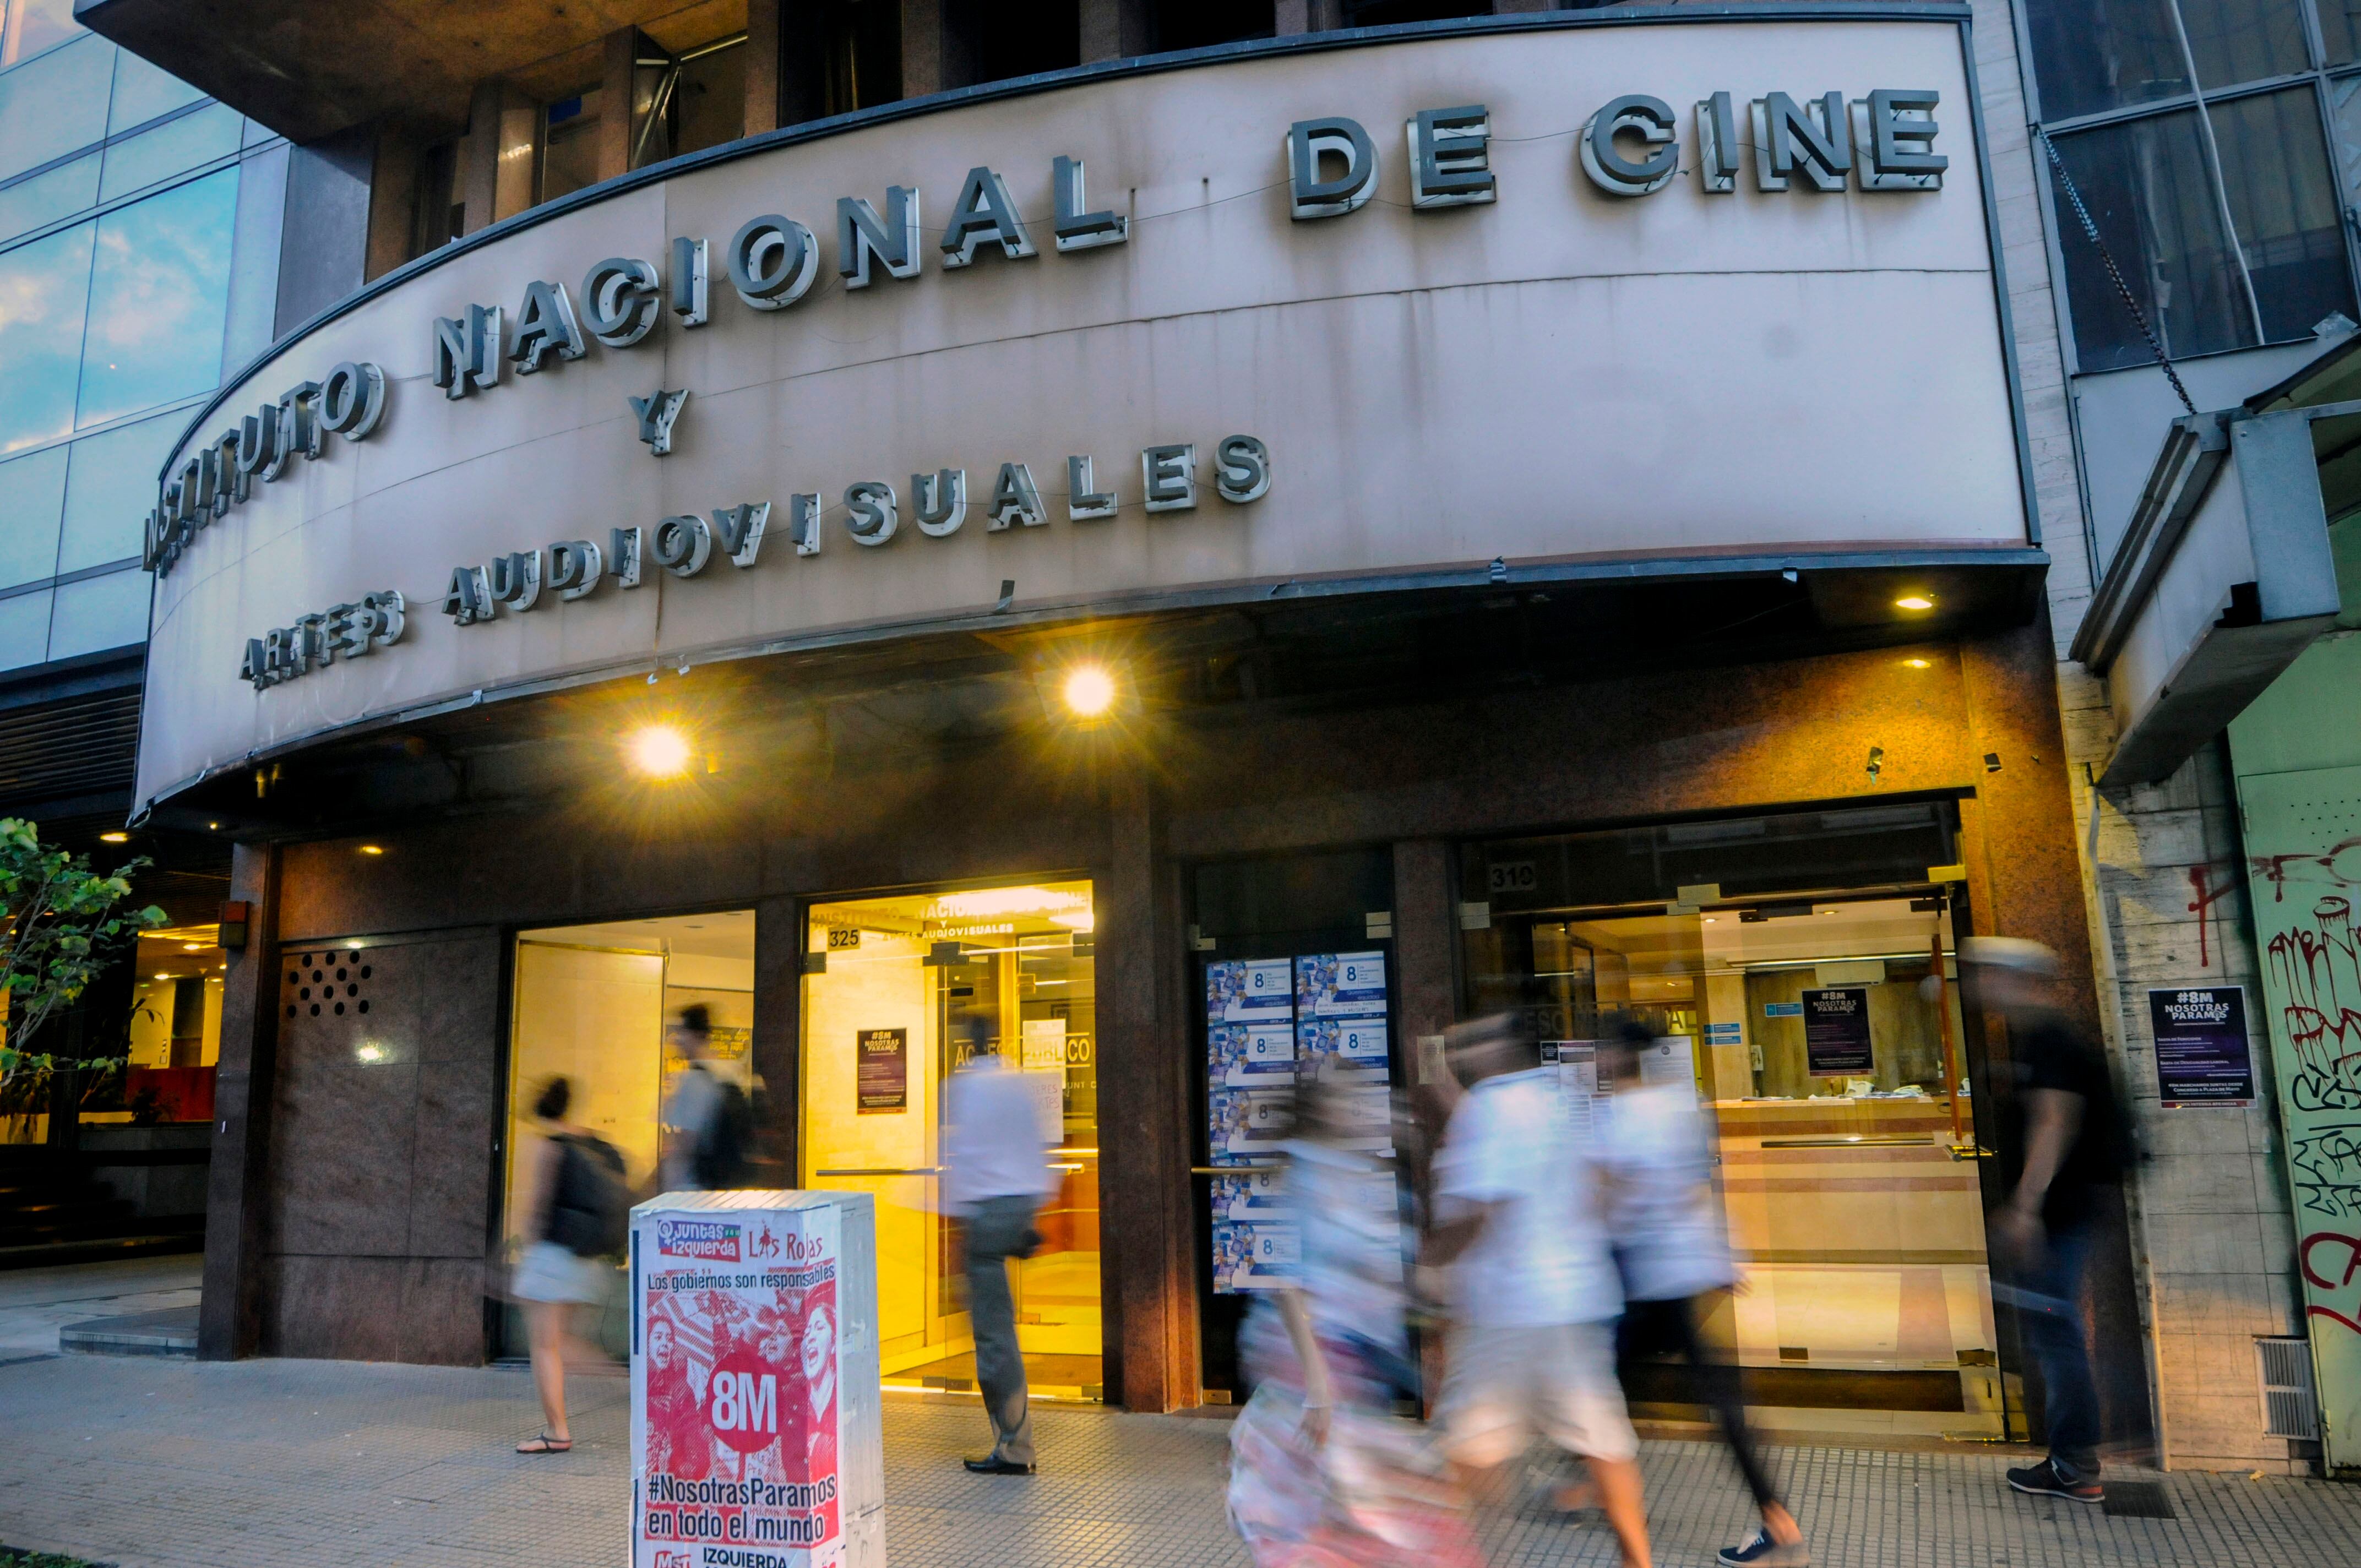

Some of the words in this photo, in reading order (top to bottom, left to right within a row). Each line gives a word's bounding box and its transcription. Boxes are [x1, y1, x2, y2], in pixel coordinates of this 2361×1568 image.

[142, 361, 384, 574] NSTITUTO
[433, 155, 1127, 400] NACIONAL
[1287, 105, 1497, 220] DE
[1579, 89, 1948, 197] CINE
[627, 389, 689, 456] Y
[239, 590, 404, 690] ARTES
[443, 434, 1270, 626] AUDIOVISUALES
[829, 929, 859, 948] 325
[1254, 973, 1264, 988] 8
[1347, 966, 1357, 982] 8
[1821, 992, 1846, 1000] #8M
[2177, 991, 2213, 1004] #8M
[2165, 1003, 2229, 1013] NOSOTRAS
[2172, 1010, 2228, 1020] PARAMOS
[1256, 1038, 1266, 1053] 8
[1349, 1033, 1358, 1049] 8
[1259, 1104, 1268, 1120] 8
[672, 1237, 736, 1258] izquierda
[787, 1233, 823, 1266] Rojas
[1263, 1239, 1273, 1255] 8
[648, 1274, 668, 1290] Los
[672, 1273, 731, 1293] gobiernos
[736, 1273, 757, 1288] son
[761, 1265, 835, 1291] responsables
[711, 1370, 776, 1433] 8M
[649, 1474, 836, 1508] #NosotrasParamos
[649, 1512, 672, 1534] en
[678, 1509, 722, 1538] todo
[730, 1511, 748, 1539] el
[755, 1513, 824, 1543] mundo
[703, 1547, 788, 1568] IZQUIERDA
